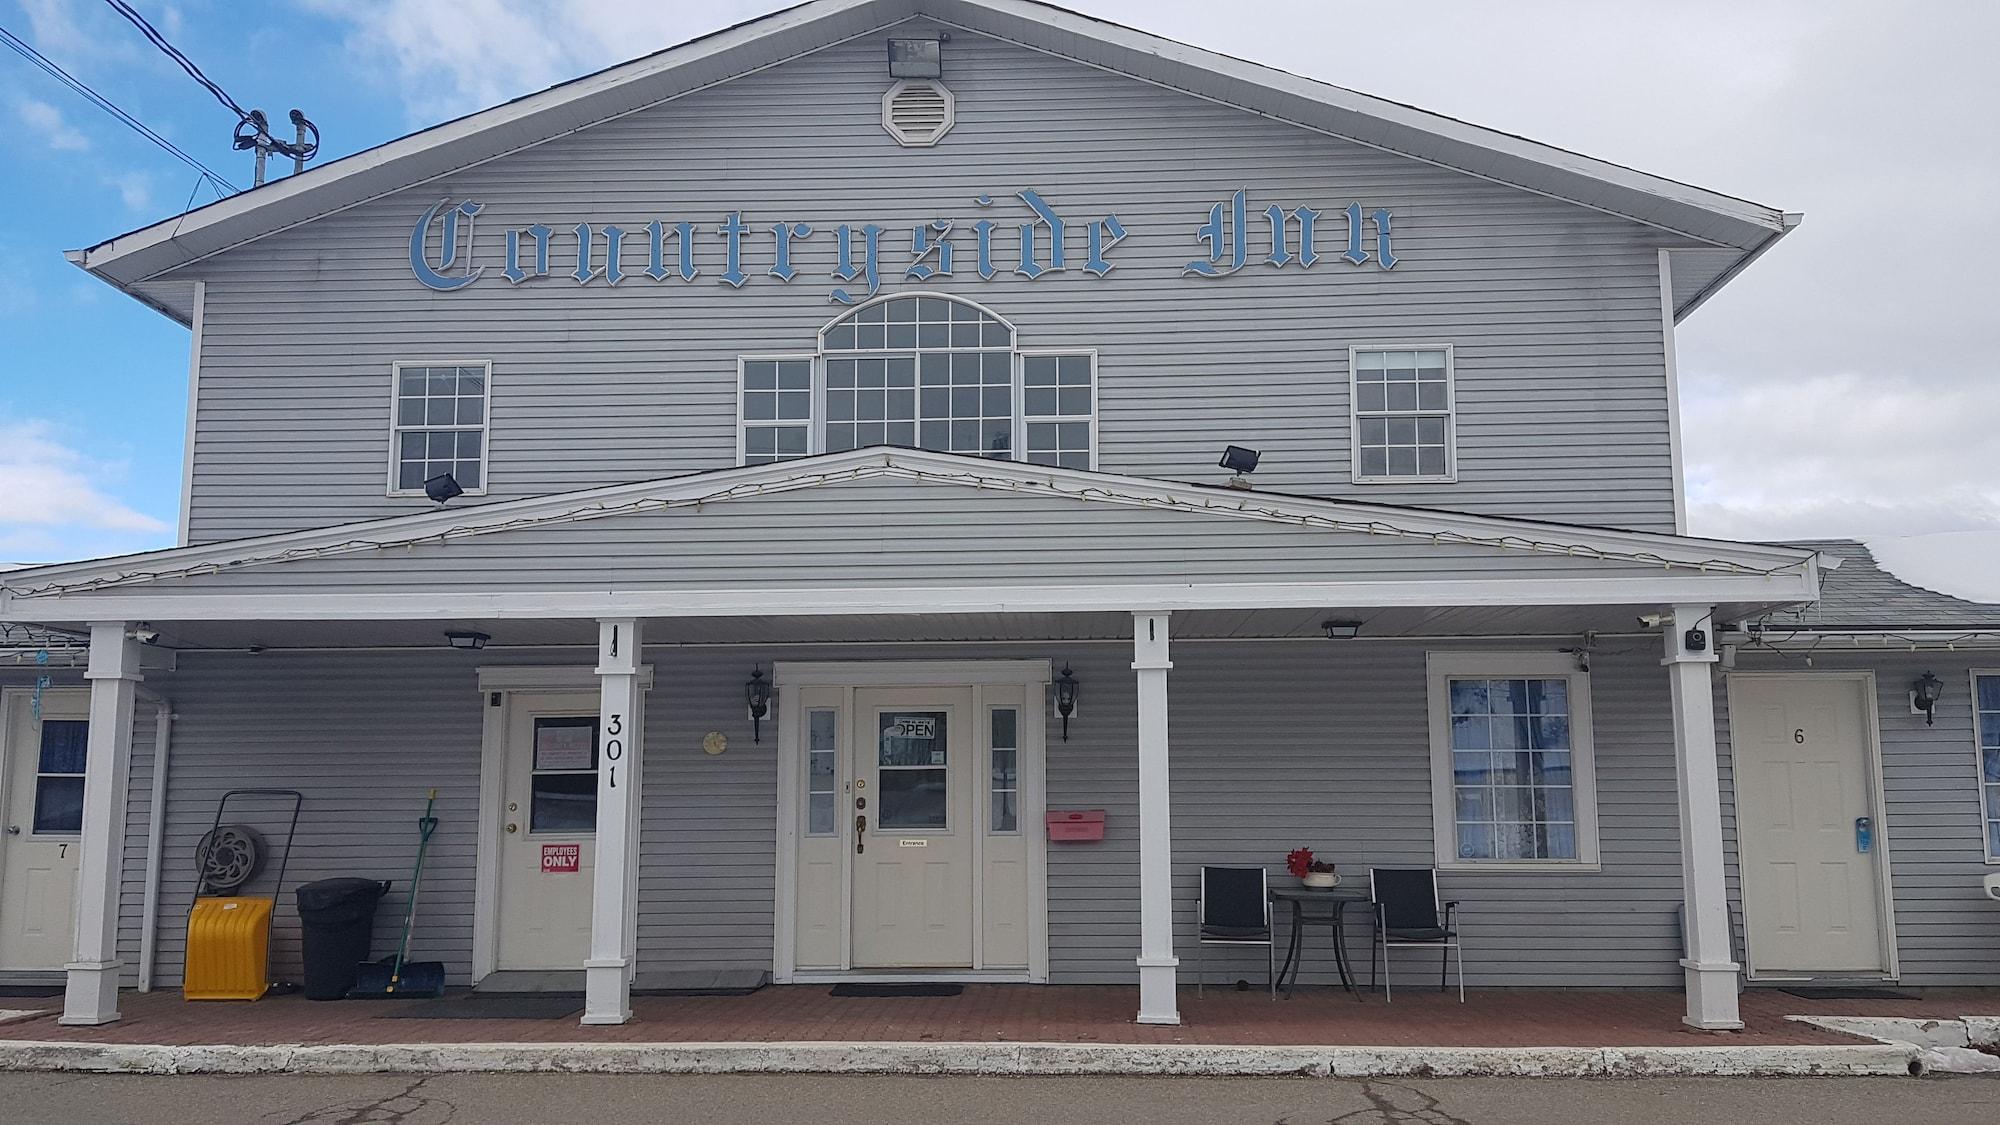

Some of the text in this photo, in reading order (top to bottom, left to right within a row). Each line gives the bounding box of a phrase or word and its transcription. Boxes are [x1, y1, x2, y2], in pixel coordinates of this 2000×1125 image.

[408, 185, 1400, 304] Countryside Inn
[1794, 728, 1804, 744] 6
[606, 714, 622, 788] 301
[59, 843, 68, 859] 7
[543, 847, 577, 856] EMPLOYEES
[543, 856, 577, 867] ONLY
